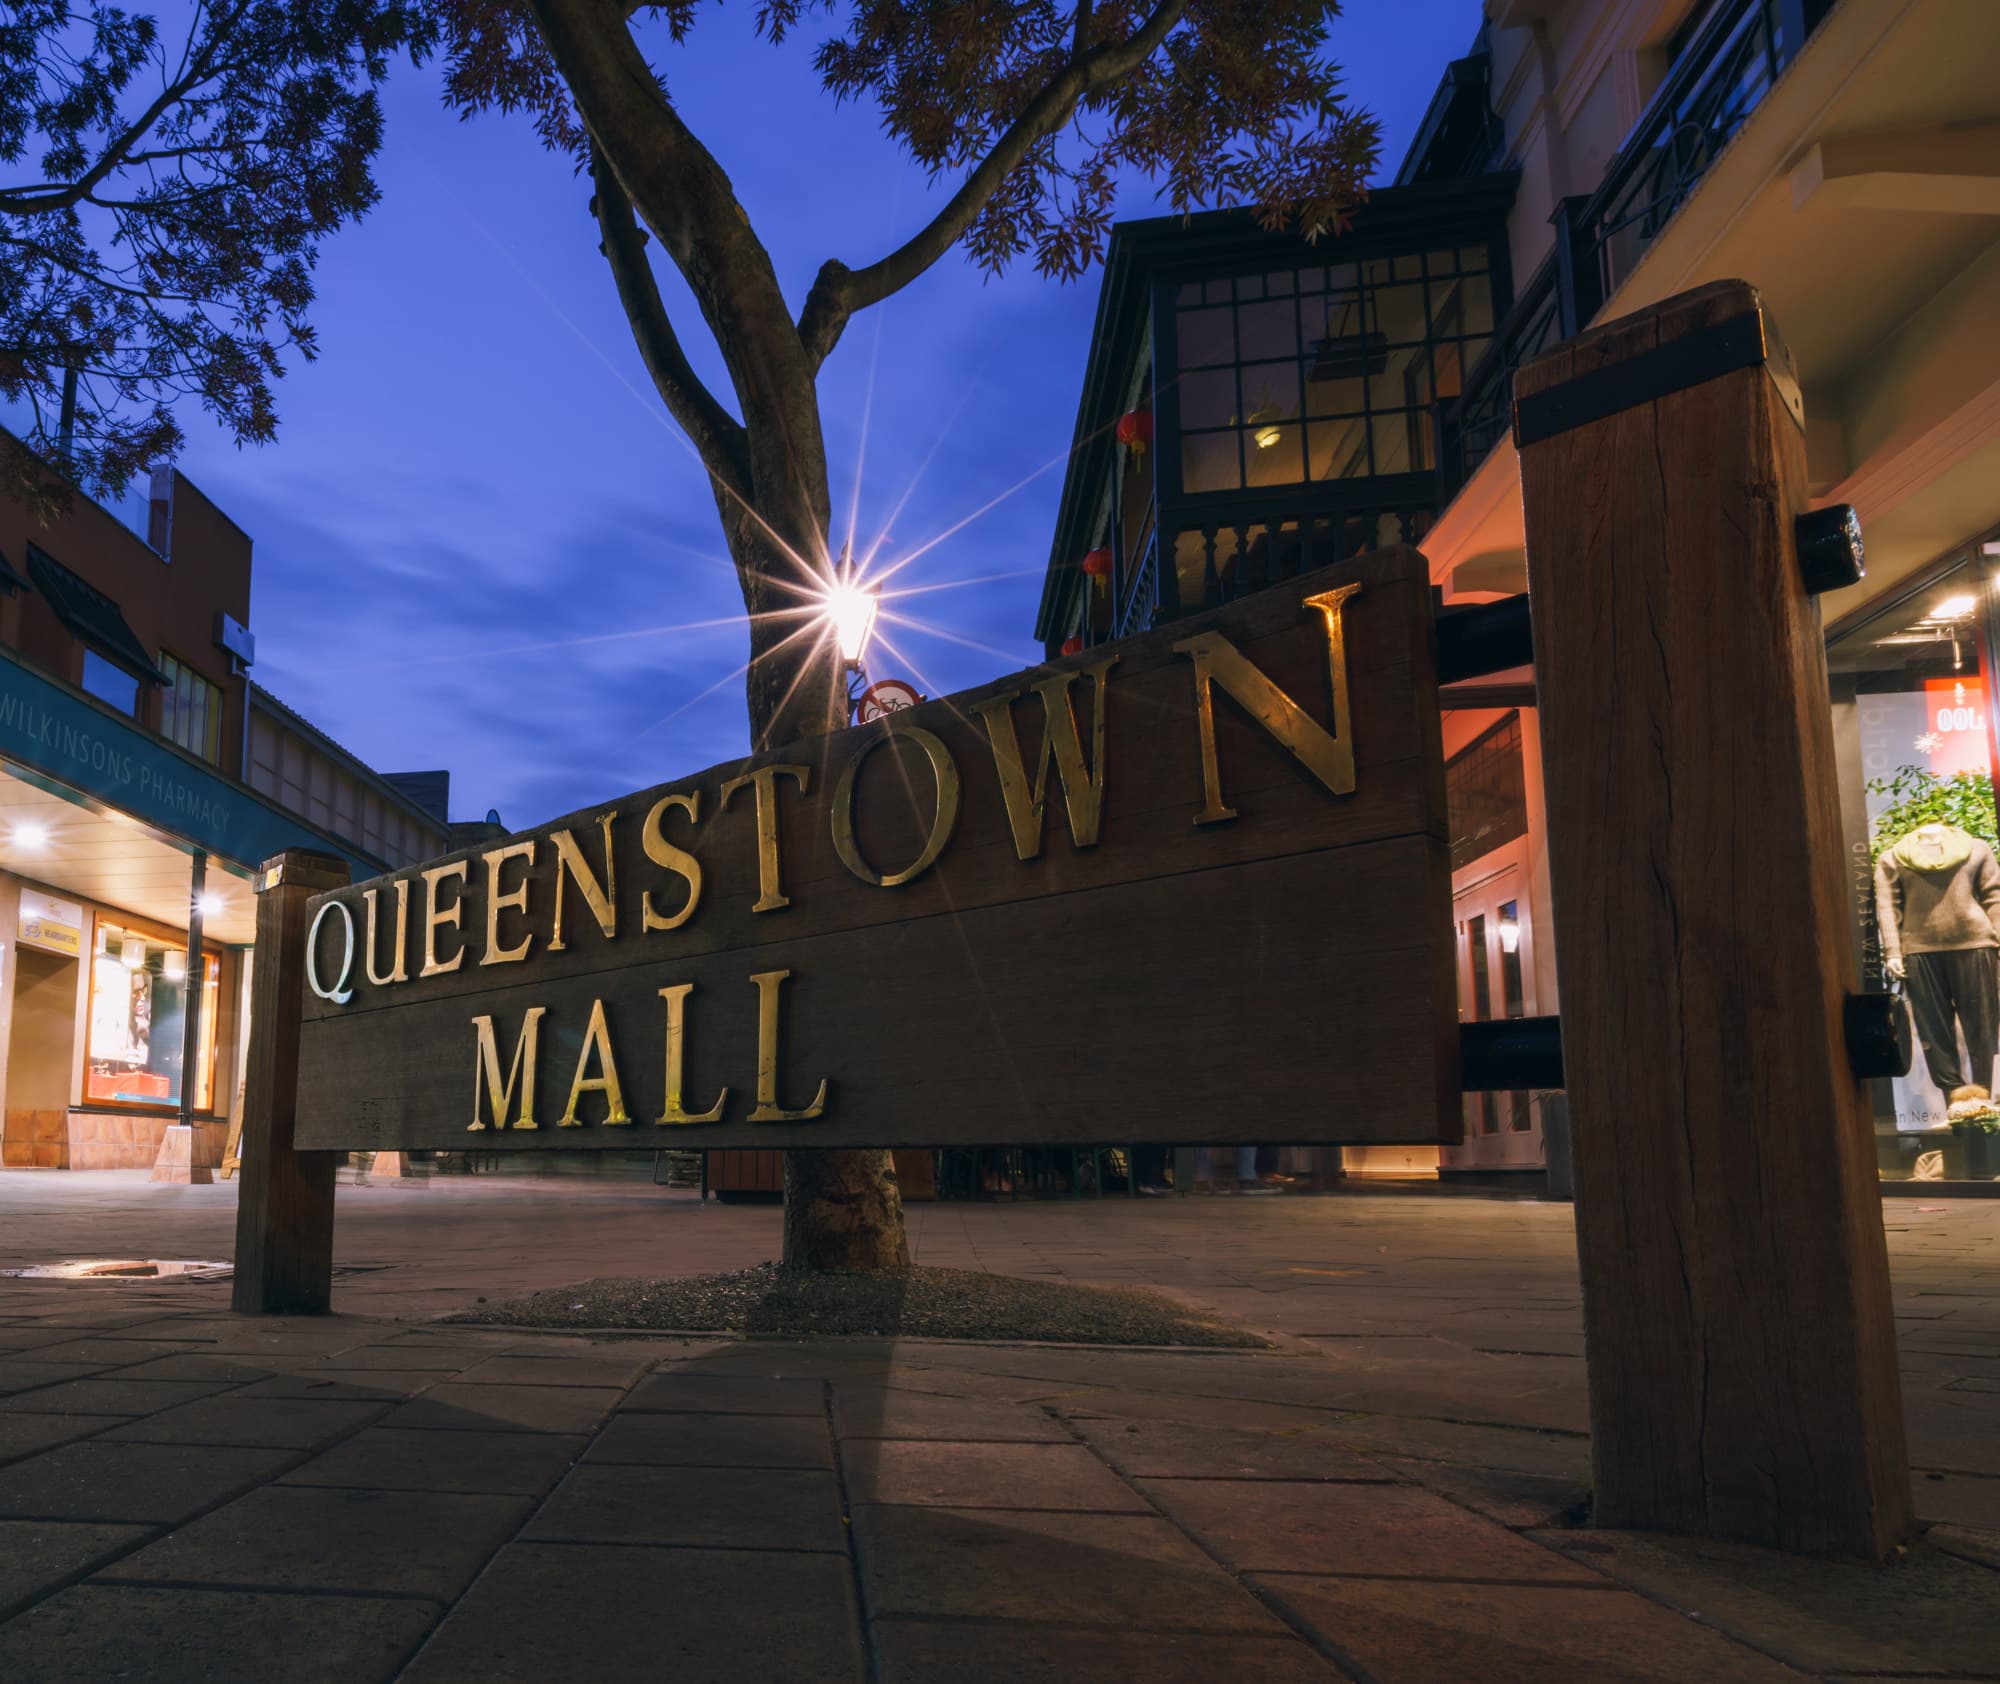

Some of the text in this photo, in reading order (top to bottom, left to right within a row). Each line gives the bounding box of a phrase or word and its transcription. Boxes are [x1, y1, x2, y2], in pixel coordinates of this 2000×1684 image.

[0, 692, 230, 832] WILKINSONS PHARMACY
[306, 581, 1362, 1005] QUEENSTOWN
[467, 969, 827, 1132] MALL
[1911, 1109, 1941, 1122] New
